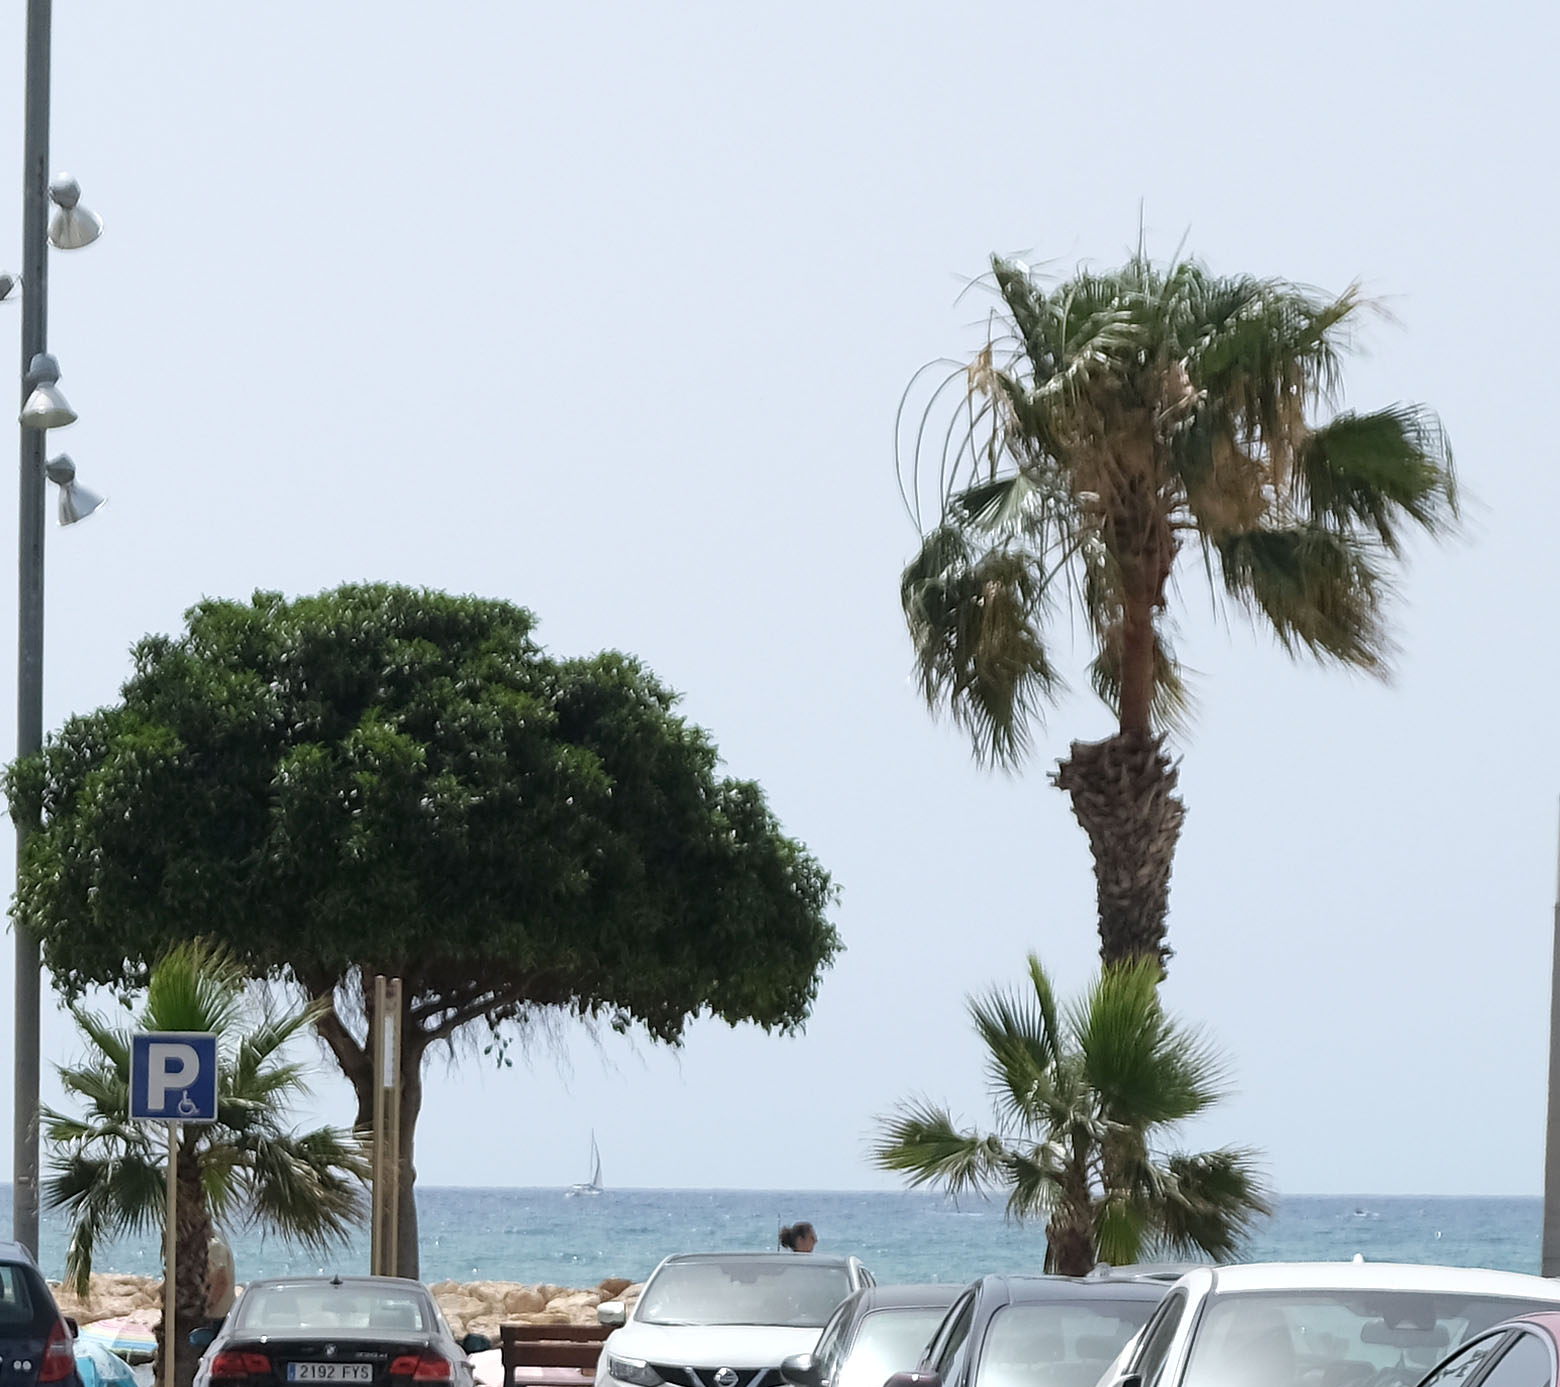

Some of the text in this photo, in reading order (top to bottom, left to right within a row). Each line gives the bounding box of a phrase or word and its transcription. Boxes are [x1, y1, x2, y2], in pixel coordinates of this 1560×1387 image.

[147, 1042, 200, 1110] P
[300, 1364, 369, 1380] 2192 FYS
